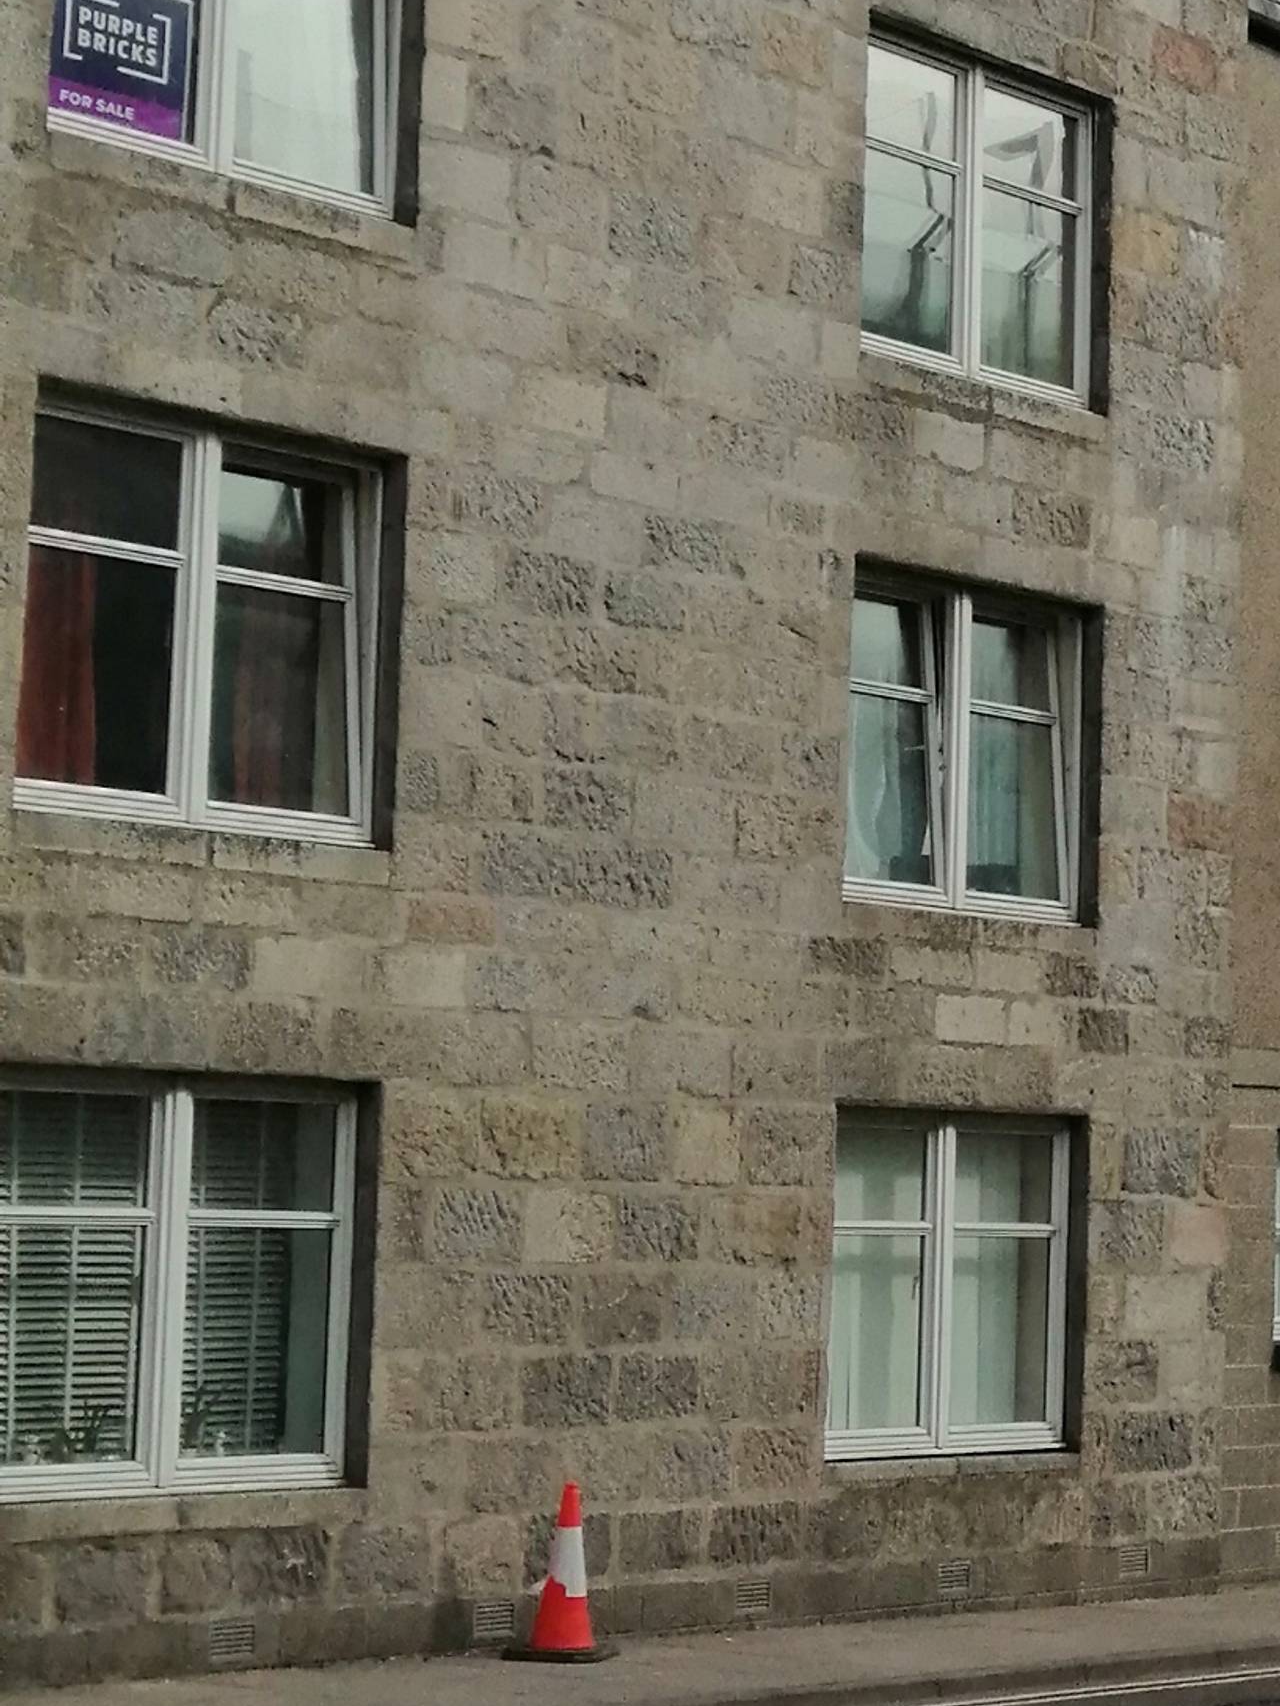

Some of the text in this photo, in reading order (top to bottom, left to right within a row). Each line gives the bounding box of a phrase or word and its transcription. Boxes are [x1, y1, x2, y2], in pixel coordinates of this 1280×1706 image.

[78, 5, 159, 45] PURPLE
[77, 28, 158, 67] BRICKS
[59, 89, 135, 121] FOR SALE
